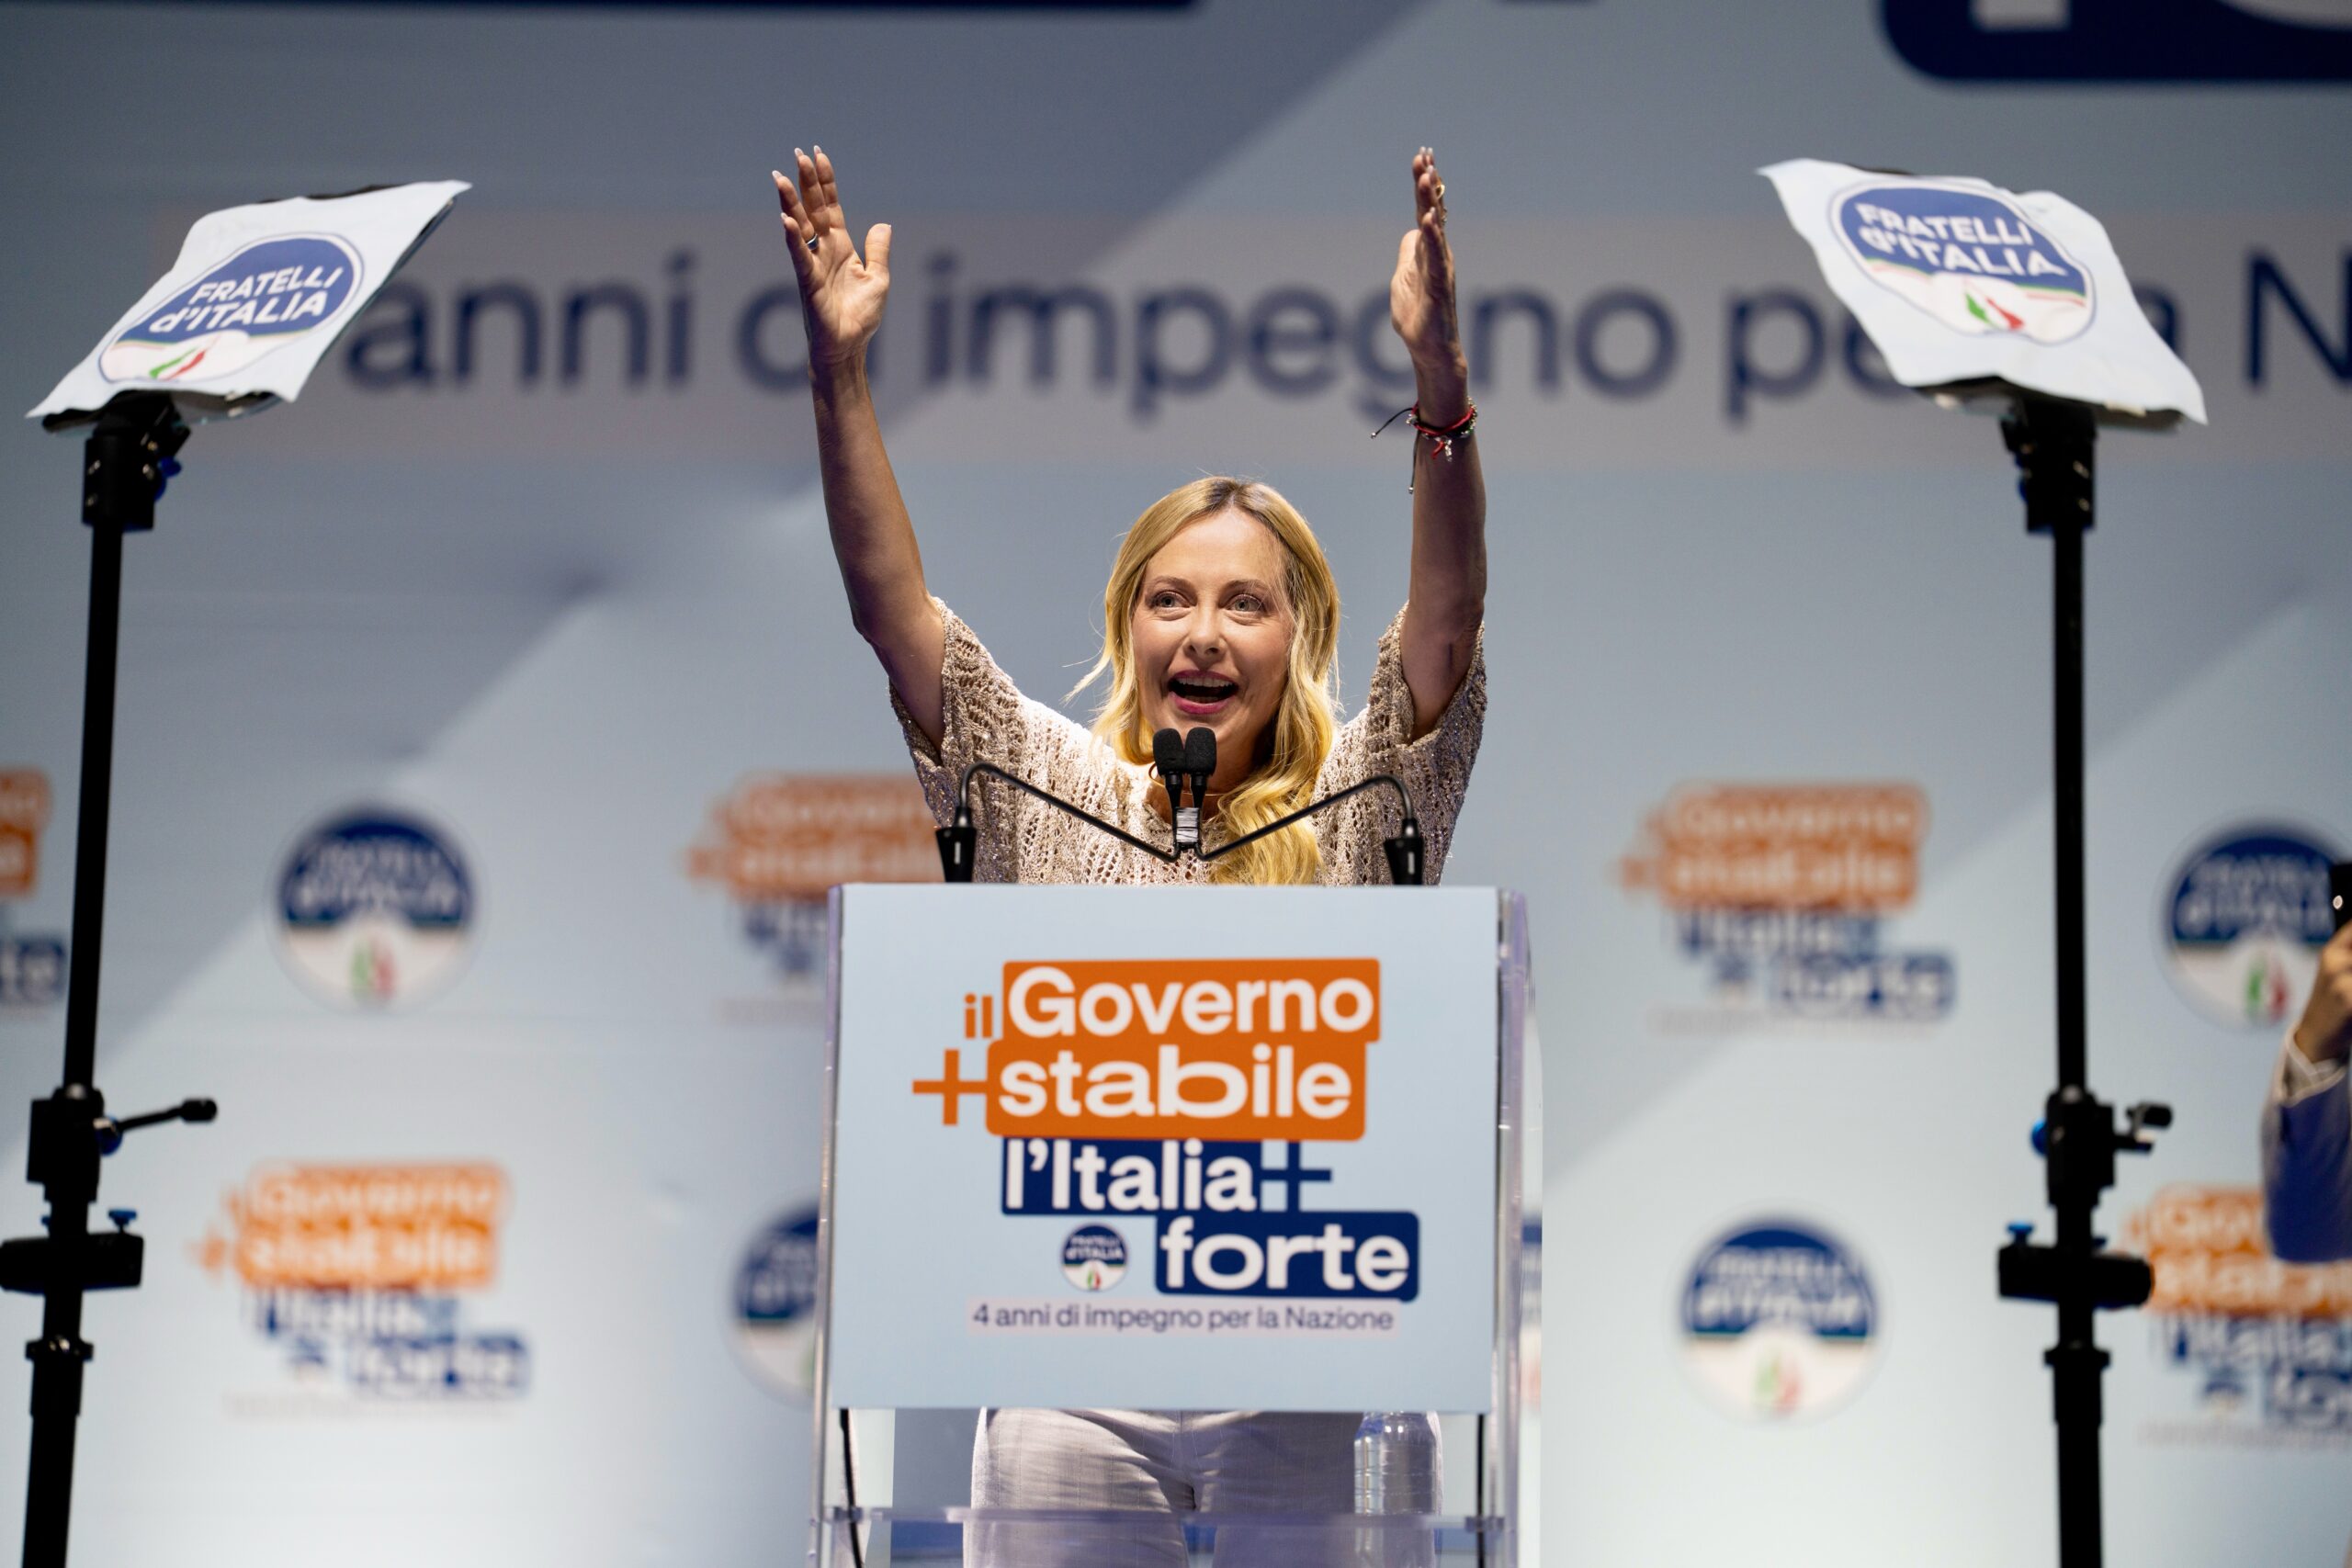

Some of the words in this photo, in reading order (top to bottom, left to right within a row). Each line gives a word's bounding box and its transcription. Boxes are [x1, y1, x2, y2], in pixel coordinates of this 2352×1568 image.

[1854, 202, 2034, 246] FRATELLI
[1859, 226, 2067, 276] d'ITALIA
[148, 290, 329, 333] d'ITALIA
[188, 265, 344, 306] FRATELLI
[348, 249, 695, 390] anni
[965, 992, 993, 1040] il
[1007, 965, 1374, 1039] Governo
[999, 1042, 1352, 1120] stabile
[1005, 1137, 1258, 1212] l'Italia
[1159, 1216, 1410, 1292] forte
[972, 1303, 989, 1326] 4
[995, 1303, 1051, 1327] anni
[1057, 1303, 1080, 1327] di
[1085, 1303, 1203, 1334] impegno
[1207, 1308, 1251, 1332] per
[1257, 1304, 1279, 1329] la
[1285, 1305, 1395, 1331] Nazione
